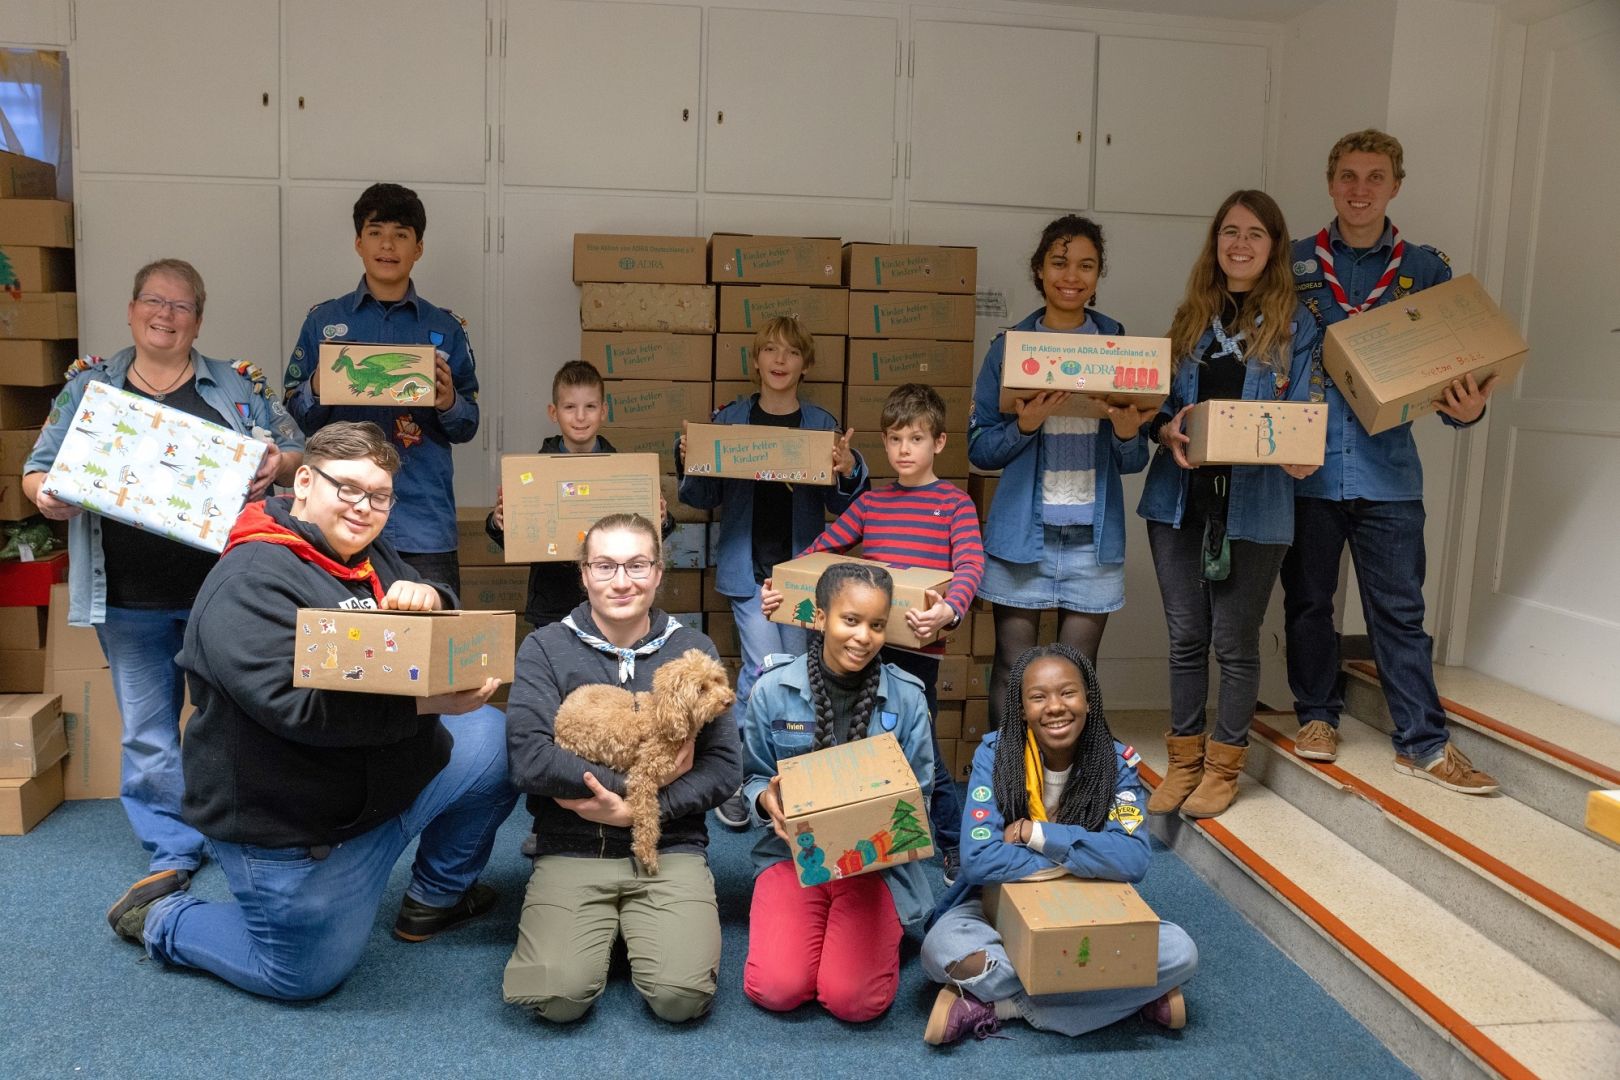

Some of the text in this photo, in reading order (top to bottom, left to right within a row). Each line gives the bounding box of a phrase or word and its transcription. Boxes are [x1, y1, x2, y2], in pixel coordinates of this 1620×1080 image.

[1021, 344, 1037, 352] Eine
[1038, 344, 1061, 353] Aktion
[1077, 346, 1099, 355] ADRA
[1100, 347, 1143, 358] Deutschland
[1083, 363, 1116, 375] ADRA
[723, 439, 778, 454] Kinder helfen
[733, 452, 769, 464] Kindern!
